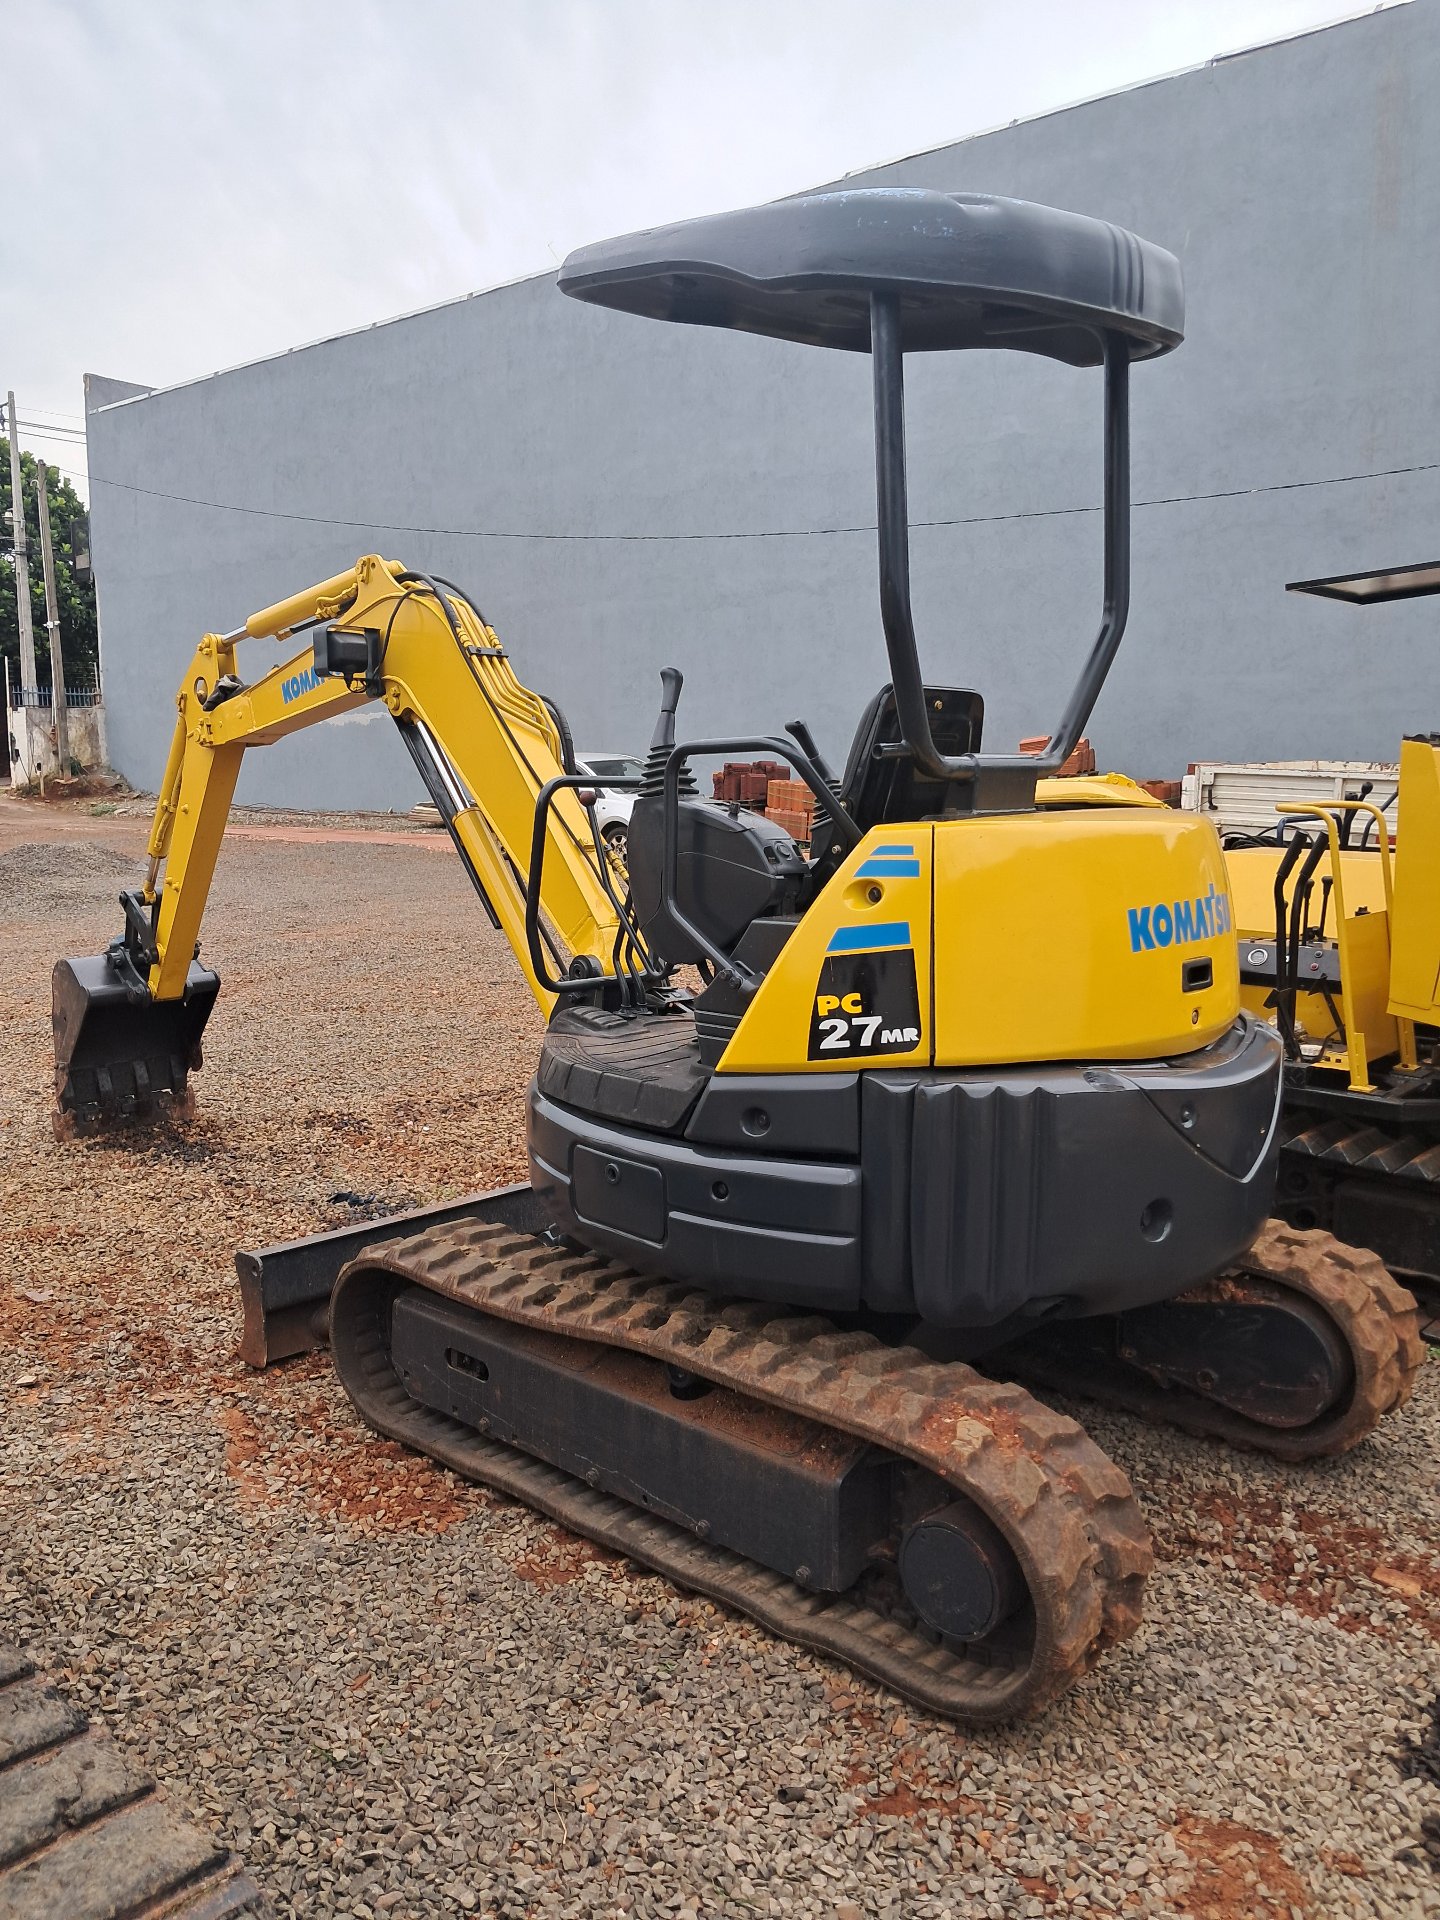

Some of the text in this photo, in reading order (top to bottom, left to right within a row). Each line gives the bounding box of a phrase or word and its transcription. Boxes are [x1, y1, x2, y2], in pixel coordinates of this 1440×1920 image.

[281, 666, 340, 704] KOMA
[1127, 882, 1231, 953] KOMATSU
[817, 992, 862, 1017] PC
